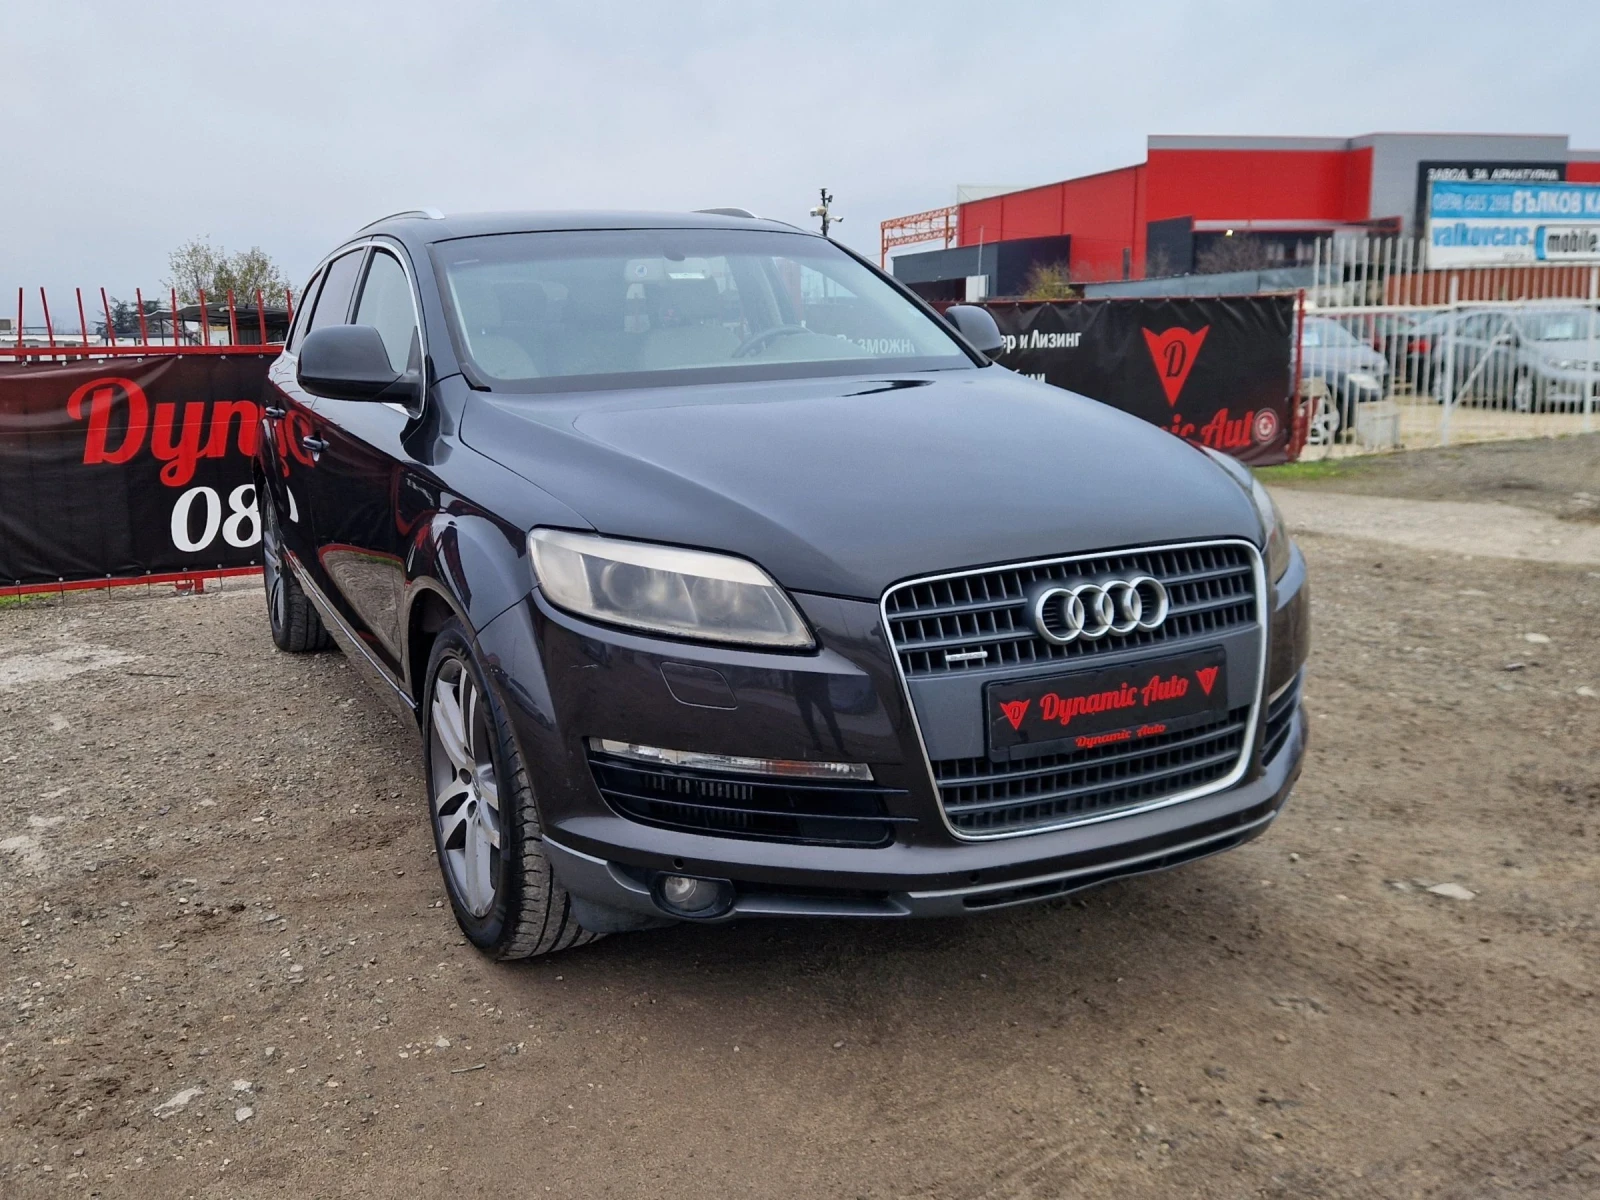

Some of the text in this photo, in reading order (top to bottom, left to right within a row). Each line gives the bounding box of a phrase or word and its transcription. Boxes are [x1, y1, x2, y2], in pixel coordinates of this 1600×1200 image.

[1030, 329, 1082, 349] Лизинг
[66, 377, 264, 487] Dyn
[1040, 682, 1138, 726] Dynamic
[1141, 674, 1189, 707] Auto
[1075, 723, 1167, 748] Dynamic Auto
